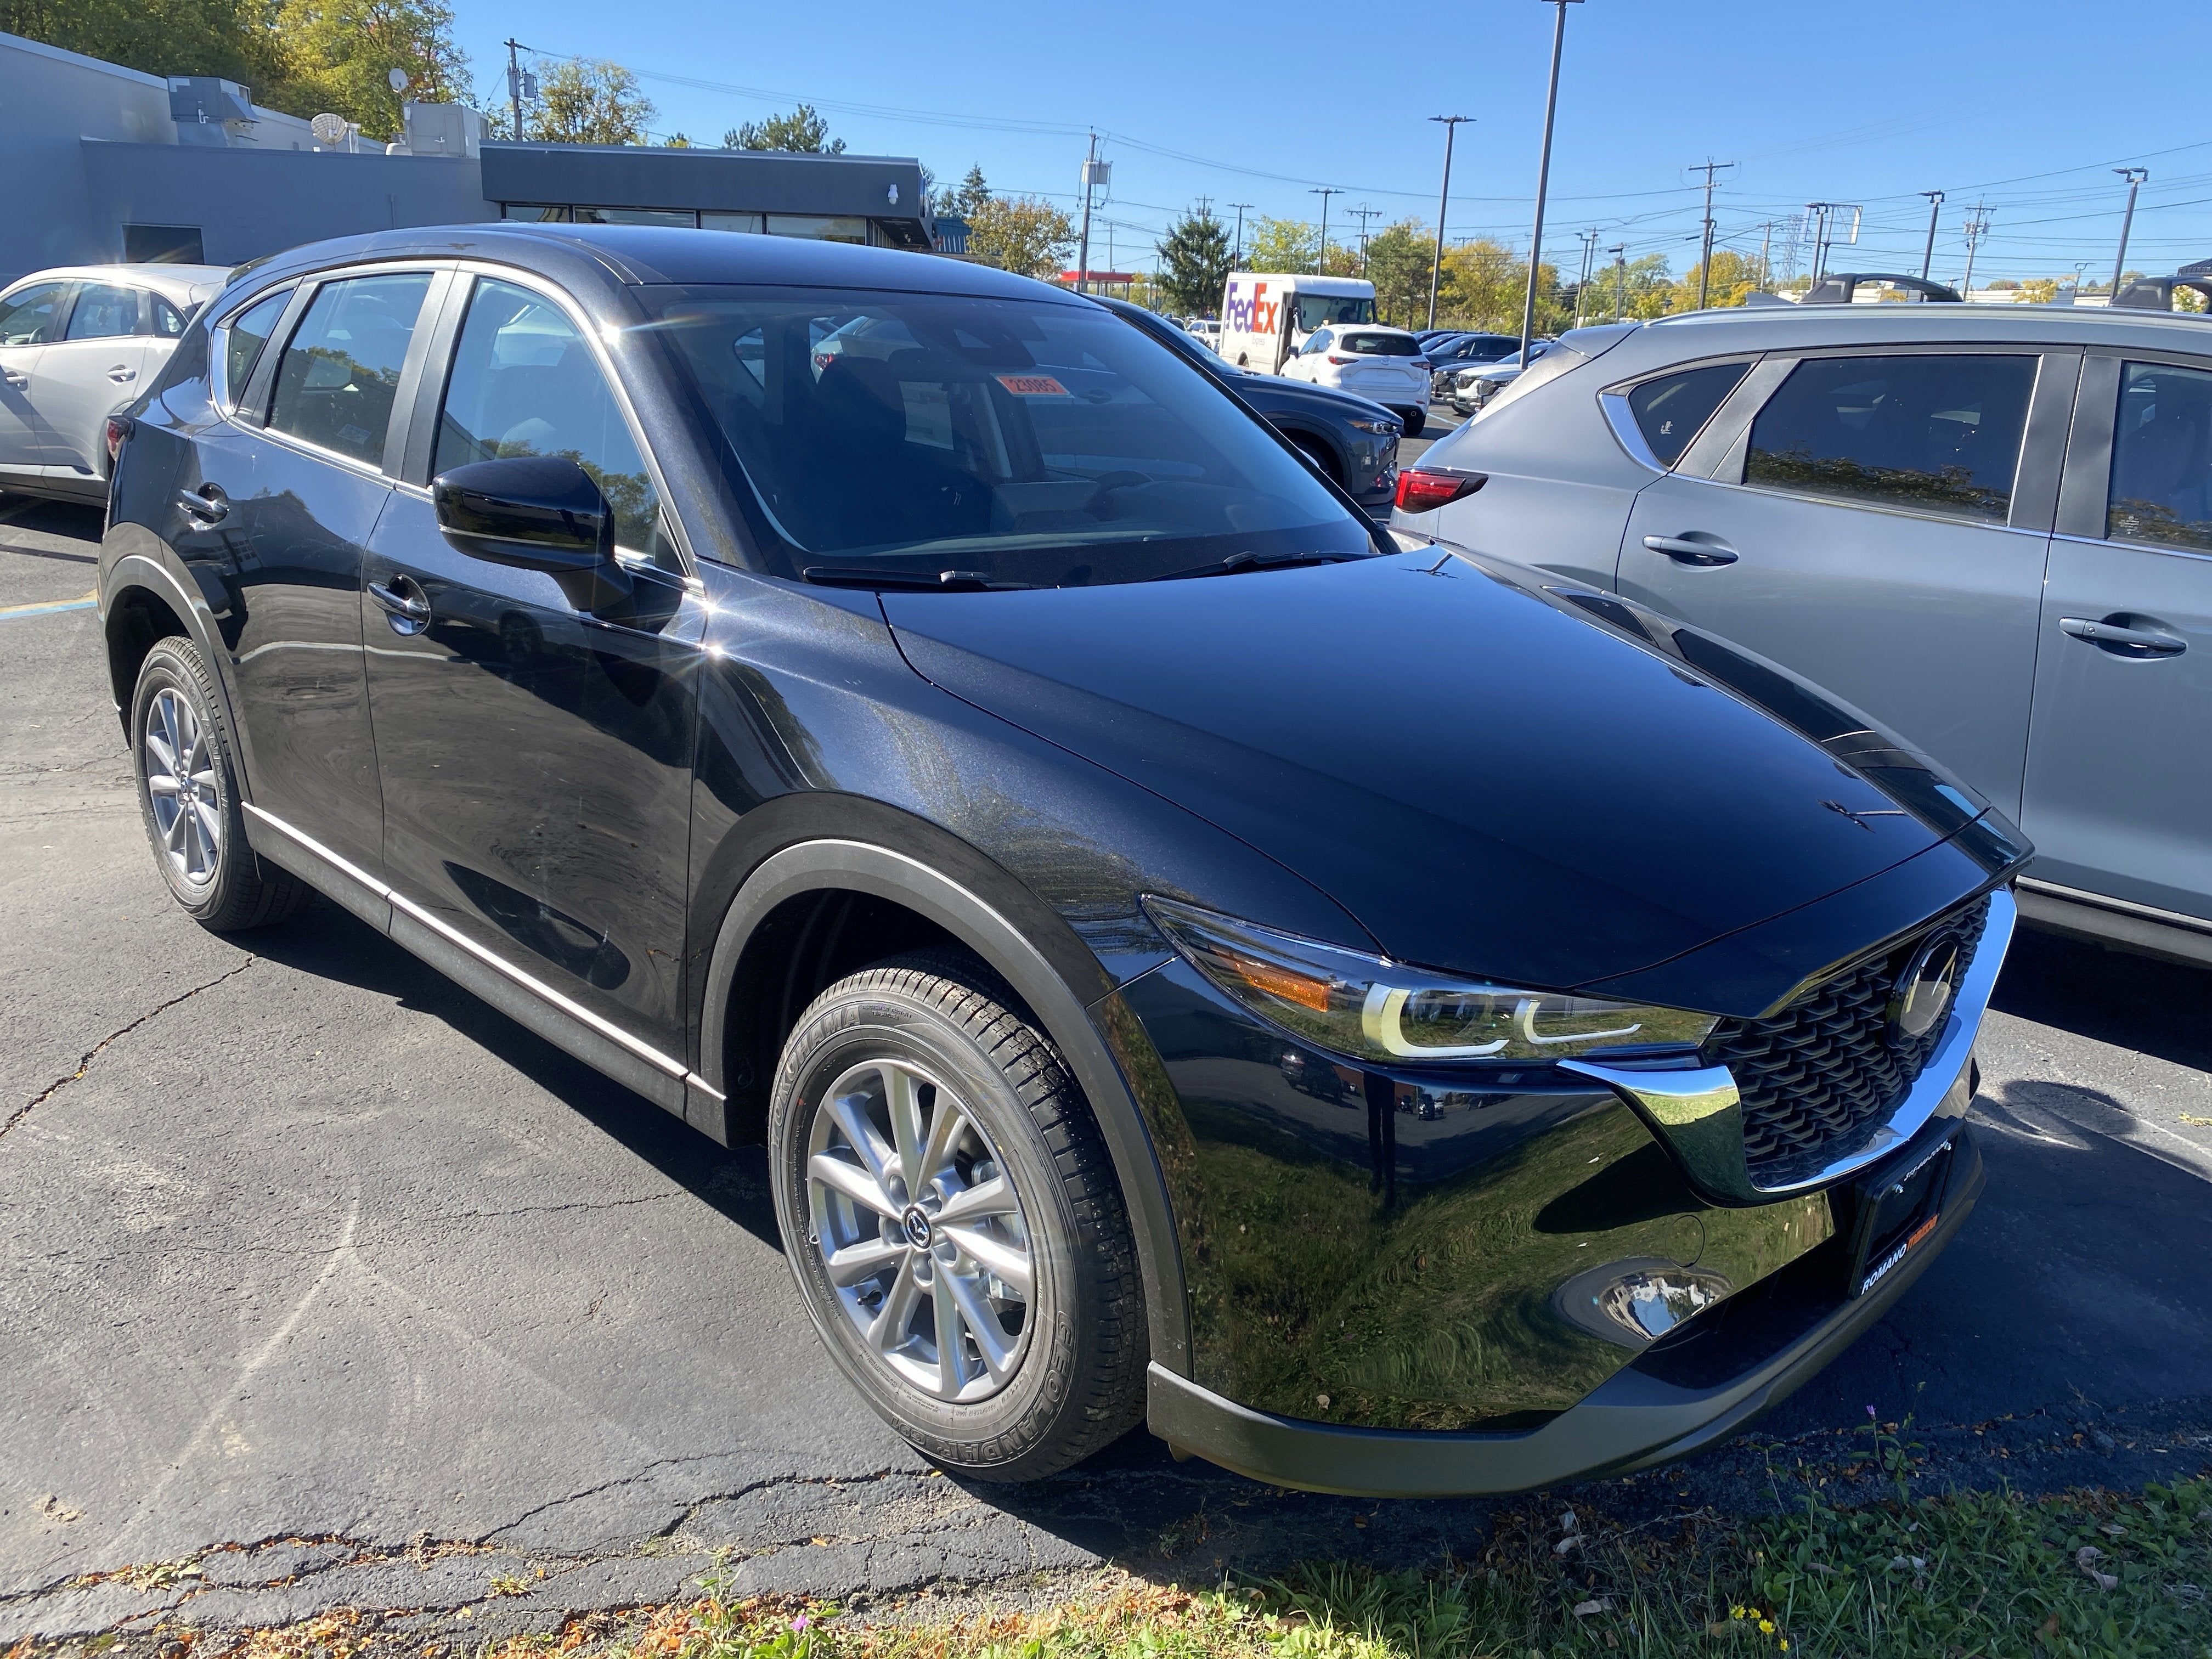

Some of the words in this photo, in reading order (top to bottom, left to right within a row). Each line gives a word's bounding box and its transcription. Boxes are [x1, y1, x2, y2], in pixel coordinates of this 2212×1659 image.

[1225, 281, 1279, 335] FedEx
[1252, 335, 1265, 347] Express
[1009, 379, 1057, 392] 23085
[770, 1005, 861, 1149] YOKOHAMA
[1861, 1243, 1907, 1295] ROMANO
[936, 1310, 1075, 1464] GEOLANDAR
